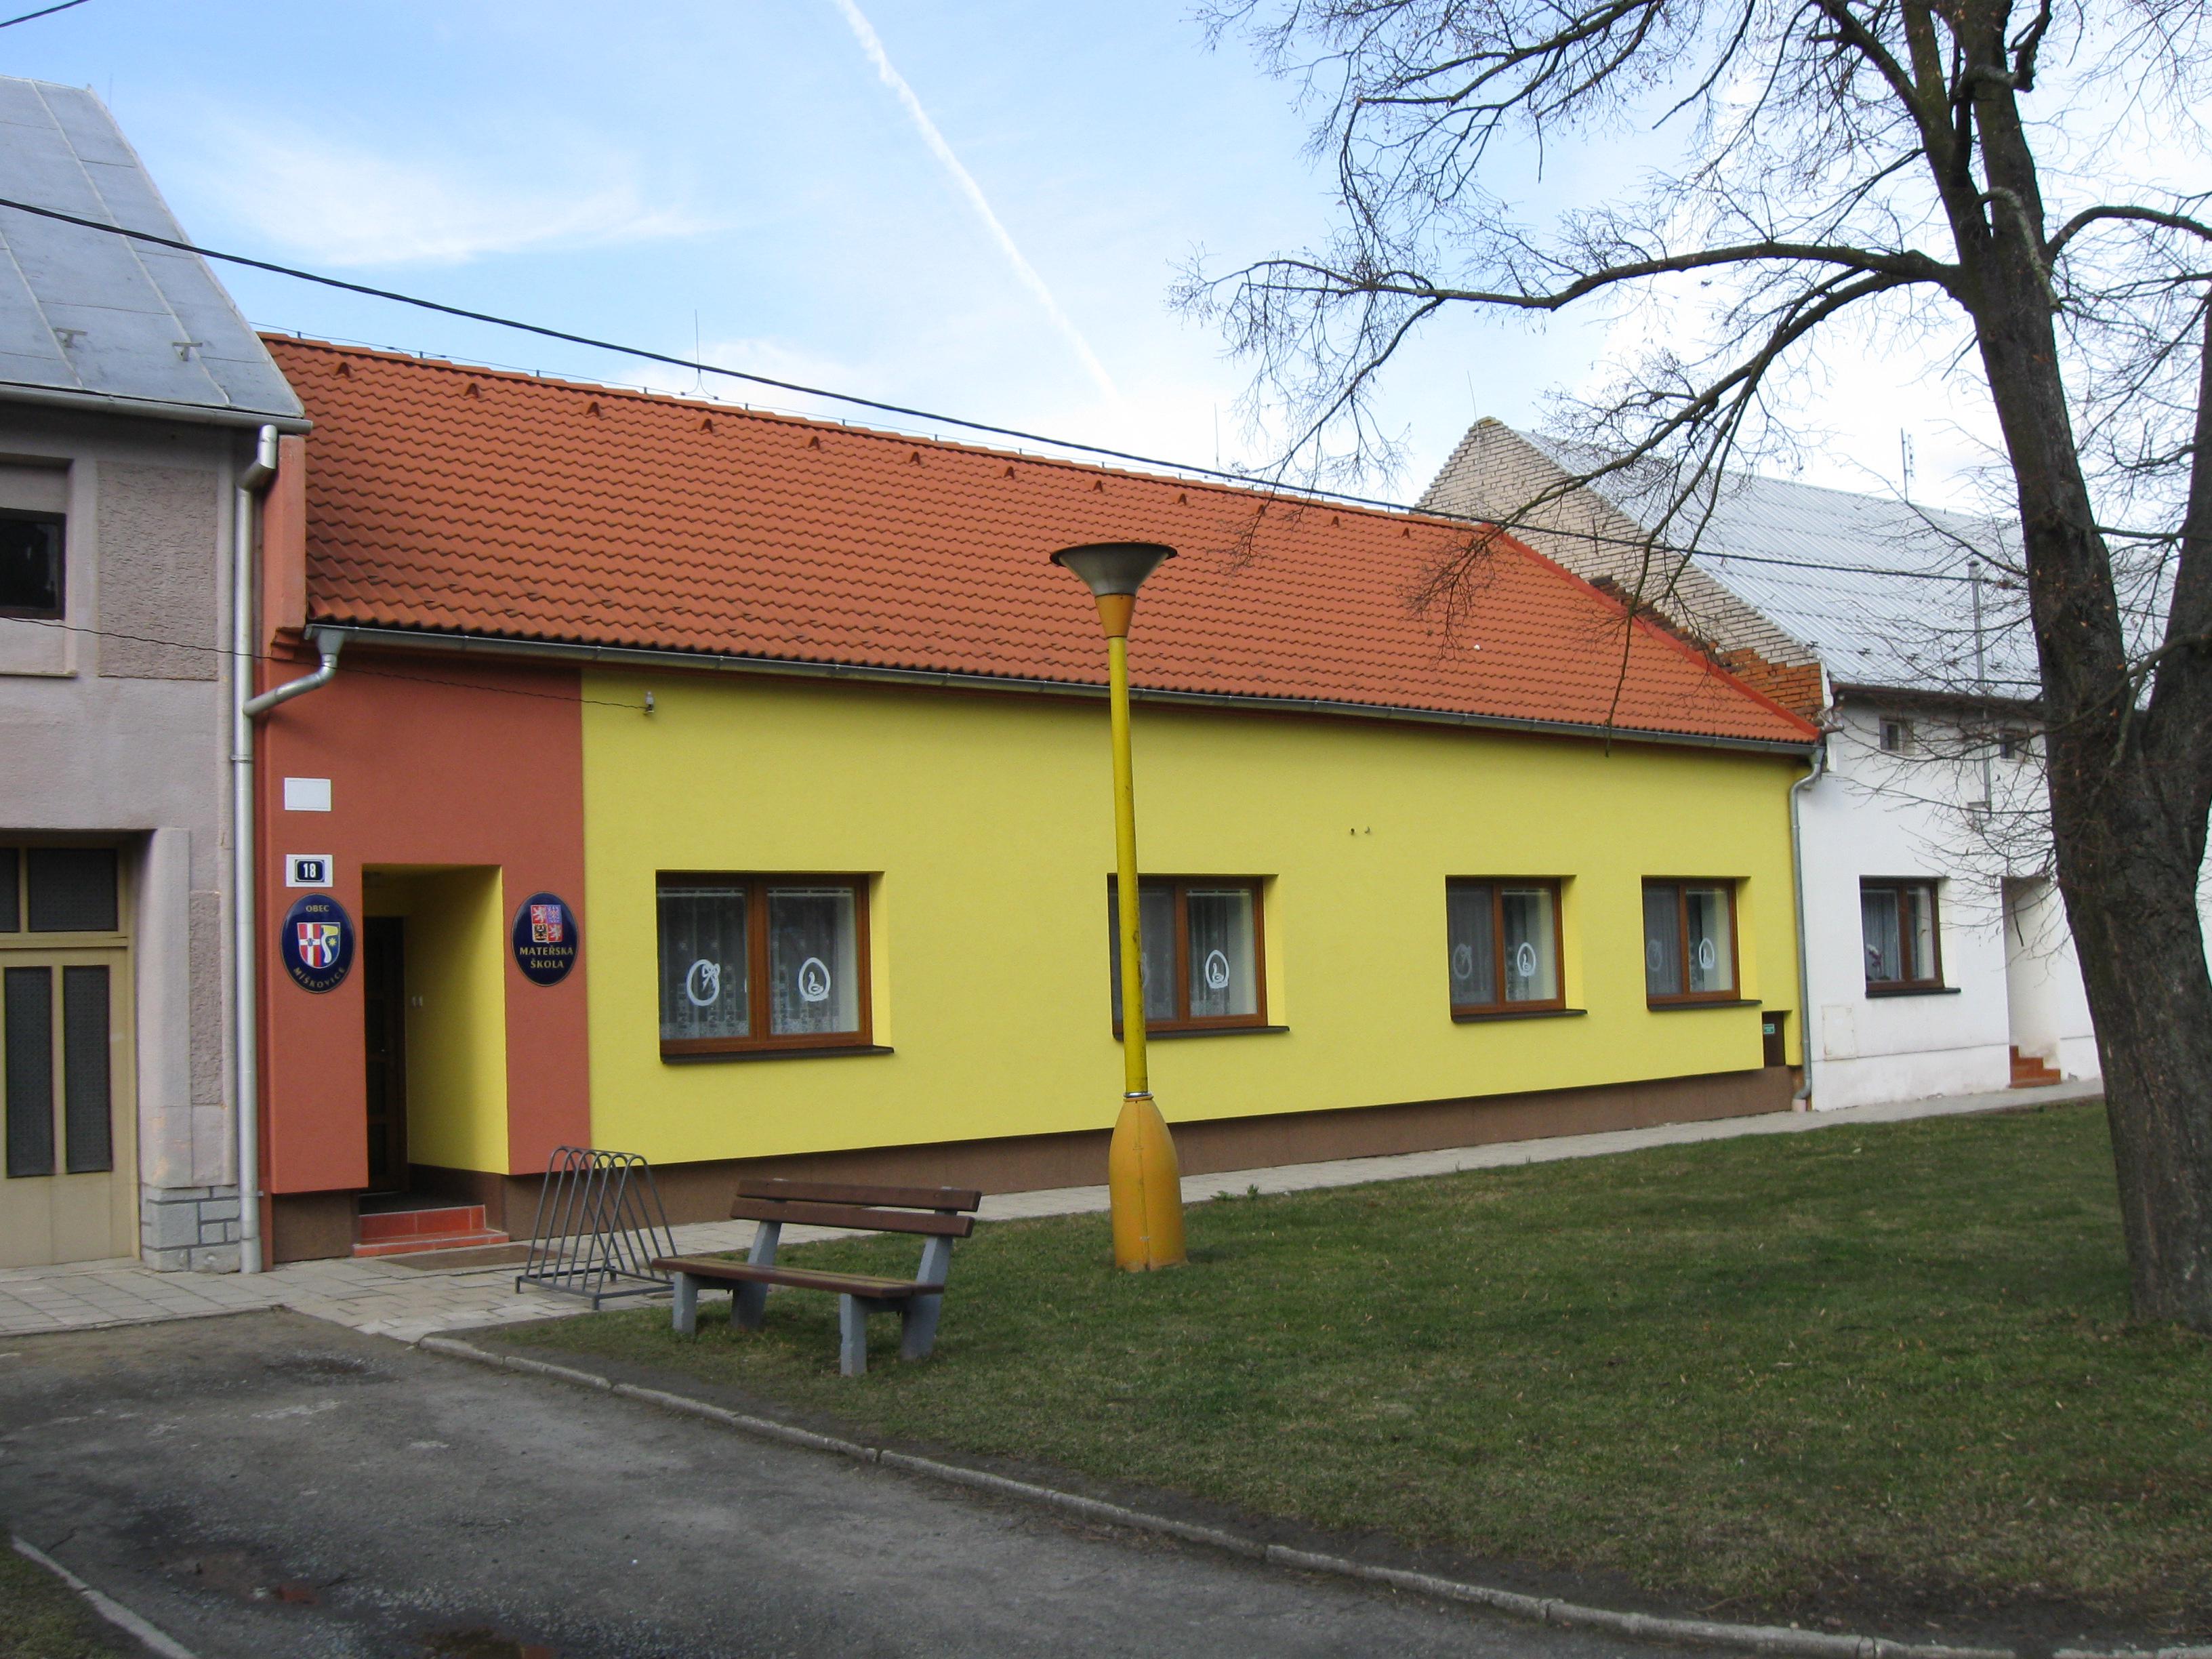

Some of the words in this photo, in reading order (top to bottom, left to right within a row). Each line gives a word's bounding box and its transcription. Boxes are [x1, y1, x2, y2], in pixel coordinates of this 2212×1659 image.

[302, 863, 316, 878] 18
[520, 945, 574, 956] MATEŘSKÁ
[530, 958, 565, 968] ŠKOLA
